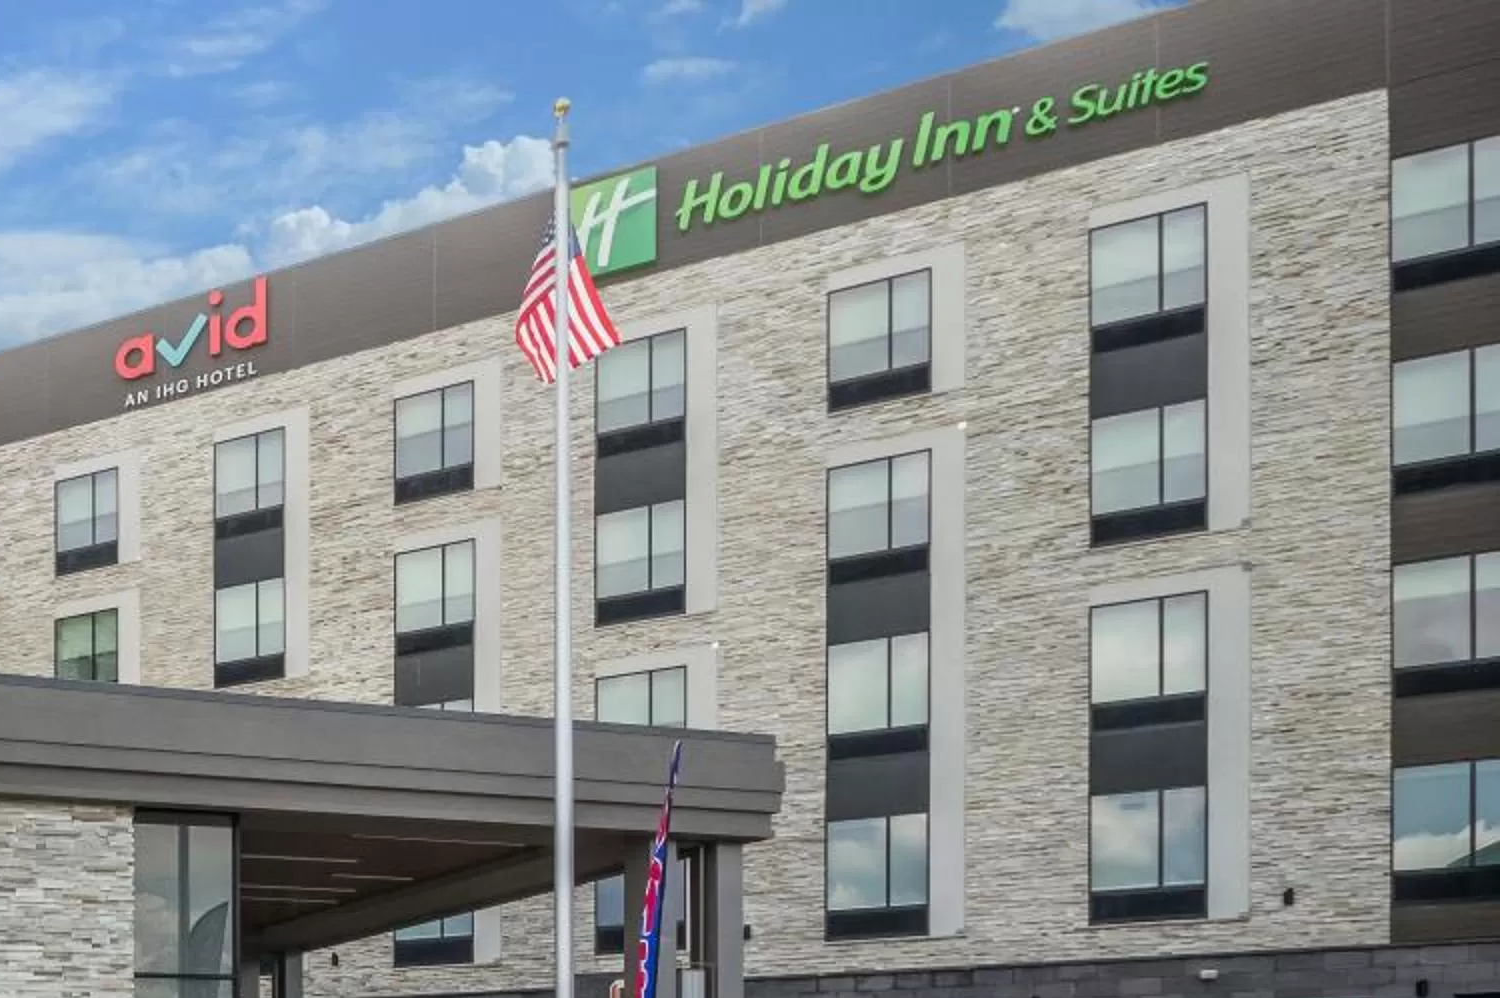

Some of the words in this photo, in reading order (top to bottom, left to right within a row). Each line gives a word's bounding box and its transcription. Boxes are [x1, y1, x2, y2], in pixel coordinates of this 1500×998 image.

[676, 136, 904, 232] Holiday
[912, 109, 1011, 168] Inn
[1024, 96, 1058, 137] &
[1067, 60, 1209, 127] Suites
[115, 272, 268, 380] avid
[123, 389, 149, 409] AN
[156, 378, 190, 400] IHG
[195, 360, 258, 390] HOTEL
